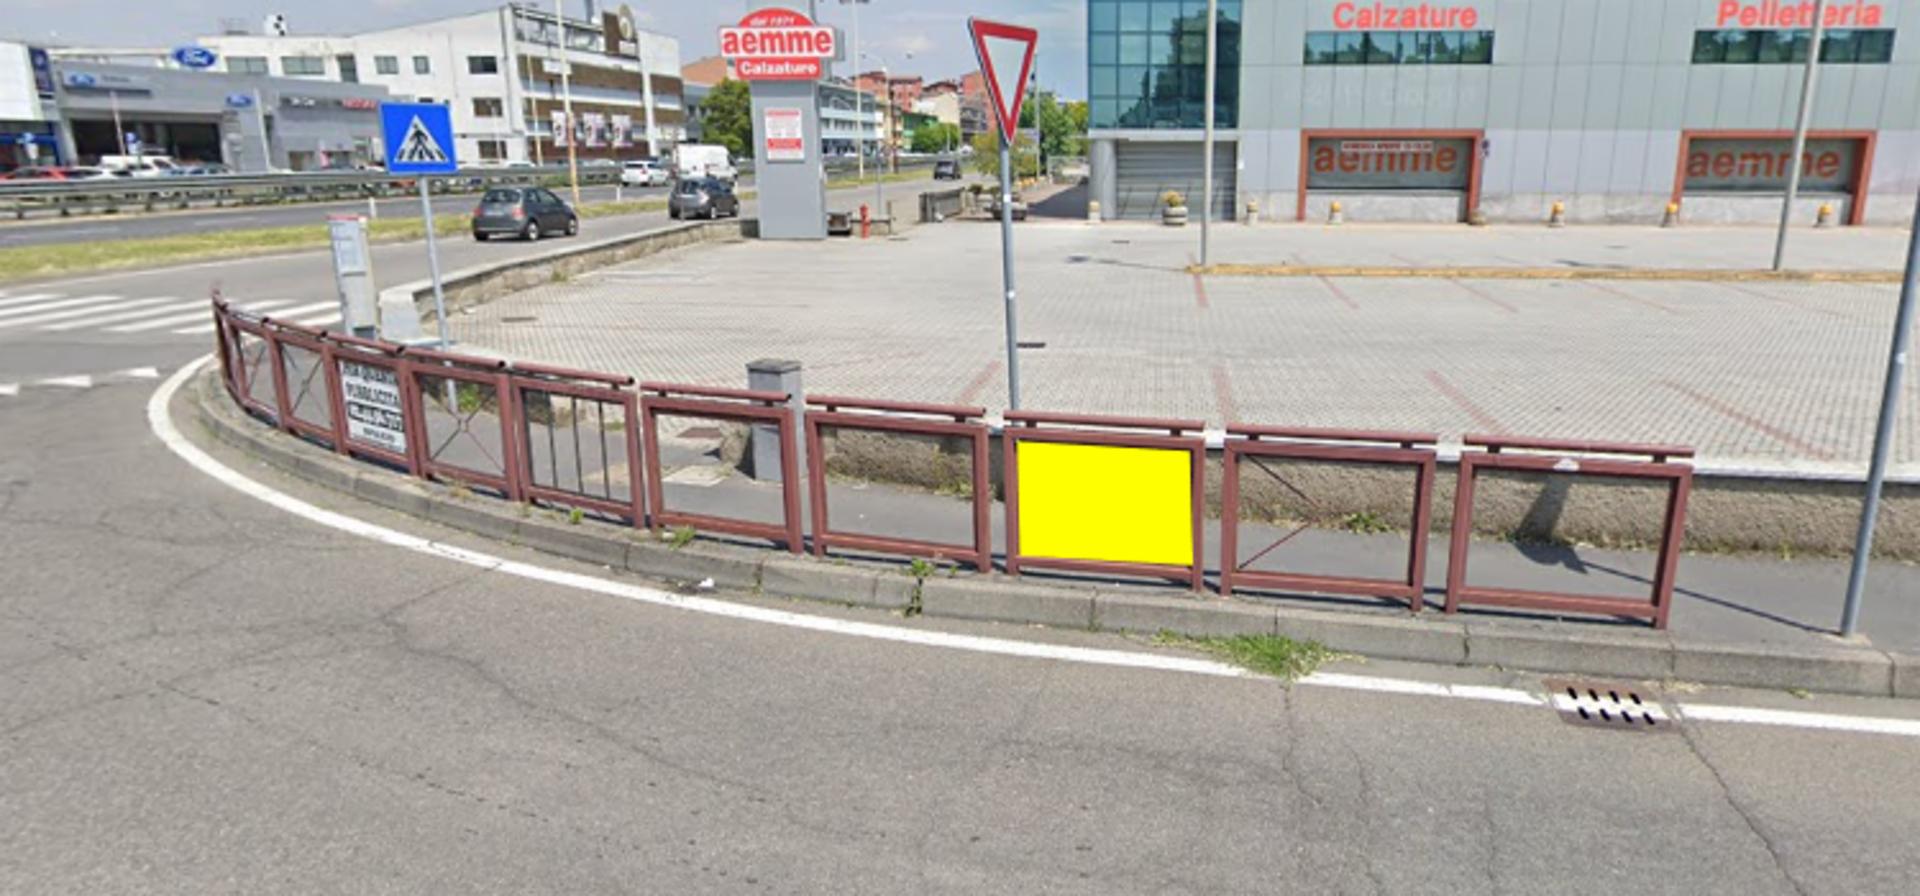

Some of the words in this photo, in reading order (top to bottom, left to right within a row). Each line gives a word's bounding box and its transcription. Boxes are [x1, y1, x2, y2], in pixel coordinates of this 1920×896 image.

[1332, 2, 1477, 28] Calzature
[1716, 0, 1883, 27] Pelleteria
[722, 30, 832, 54] aemme
[739, 60, 818, 75] Calzature
